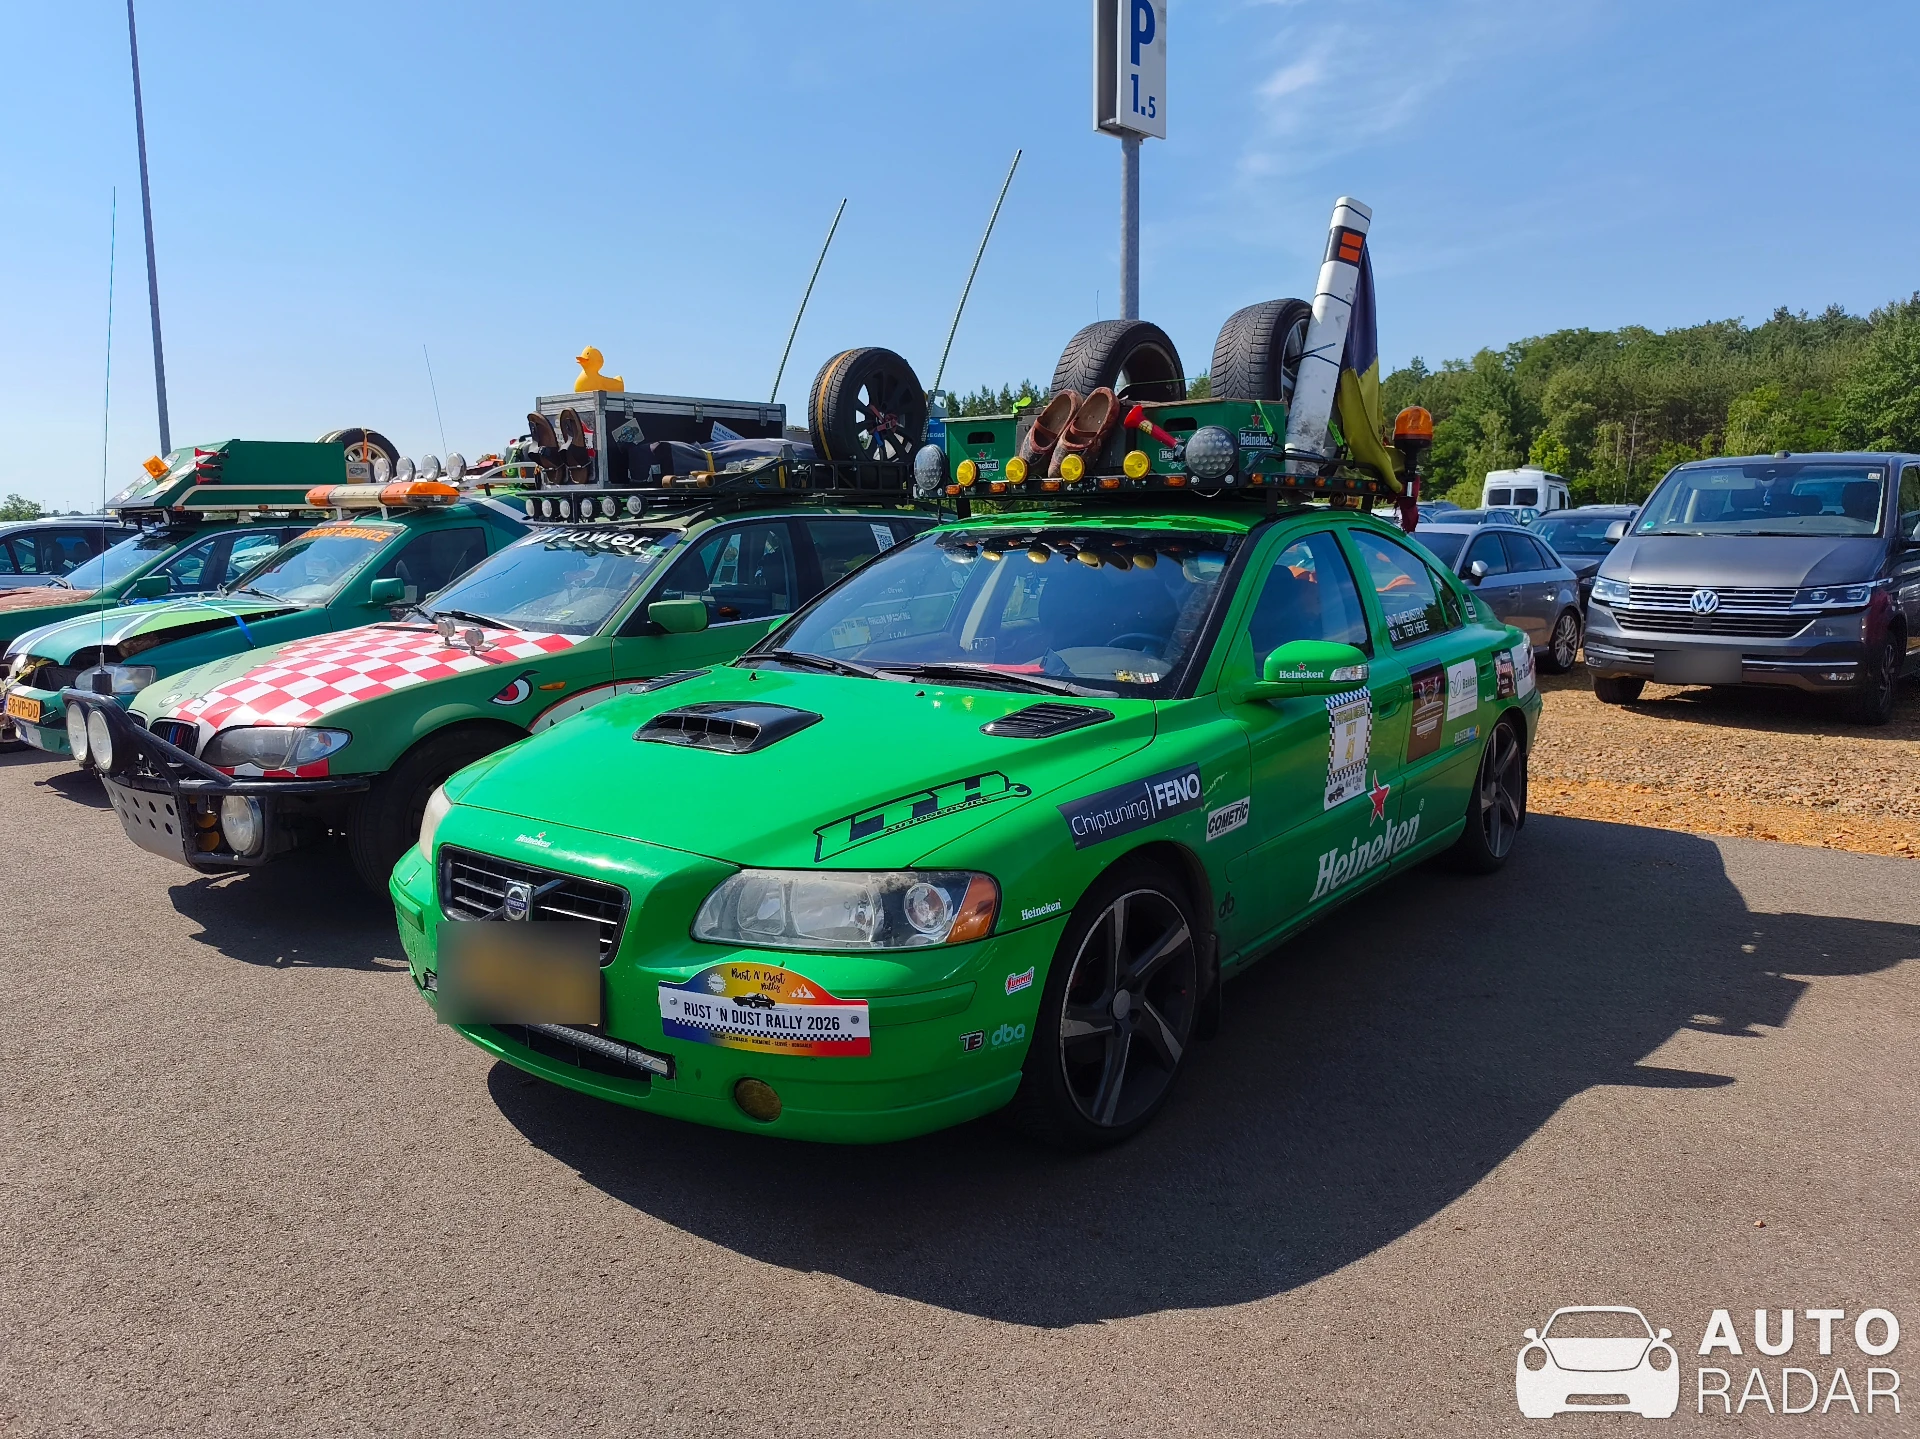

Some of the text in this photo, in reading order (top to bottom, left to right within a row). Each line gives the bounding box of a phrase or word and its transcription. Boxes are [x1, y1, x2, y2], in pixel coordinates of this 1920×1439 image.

[1130, 0, 1155, 66] P
[1130, 73, 1156, 118] 1.5
[1240, 432, 1272, 446] Heineke
[1279, 669, 1324, 679] Heineken
[1071, 773, 1201, 836] Chiptuning FENO
[1308, 814, 1420, 903] Heineken
[1021, 899, 1062, 921] Heineken
[731, 968, 751, 981] Rust
[763, 971, 785, 985] Dust
[684, 1002, 712, 1019] RUST
[732, 1010, 762, 1027] DUST
[766, 1013, 803, 1030] RALLY
[807, 1016, 840, 1031] 2026
